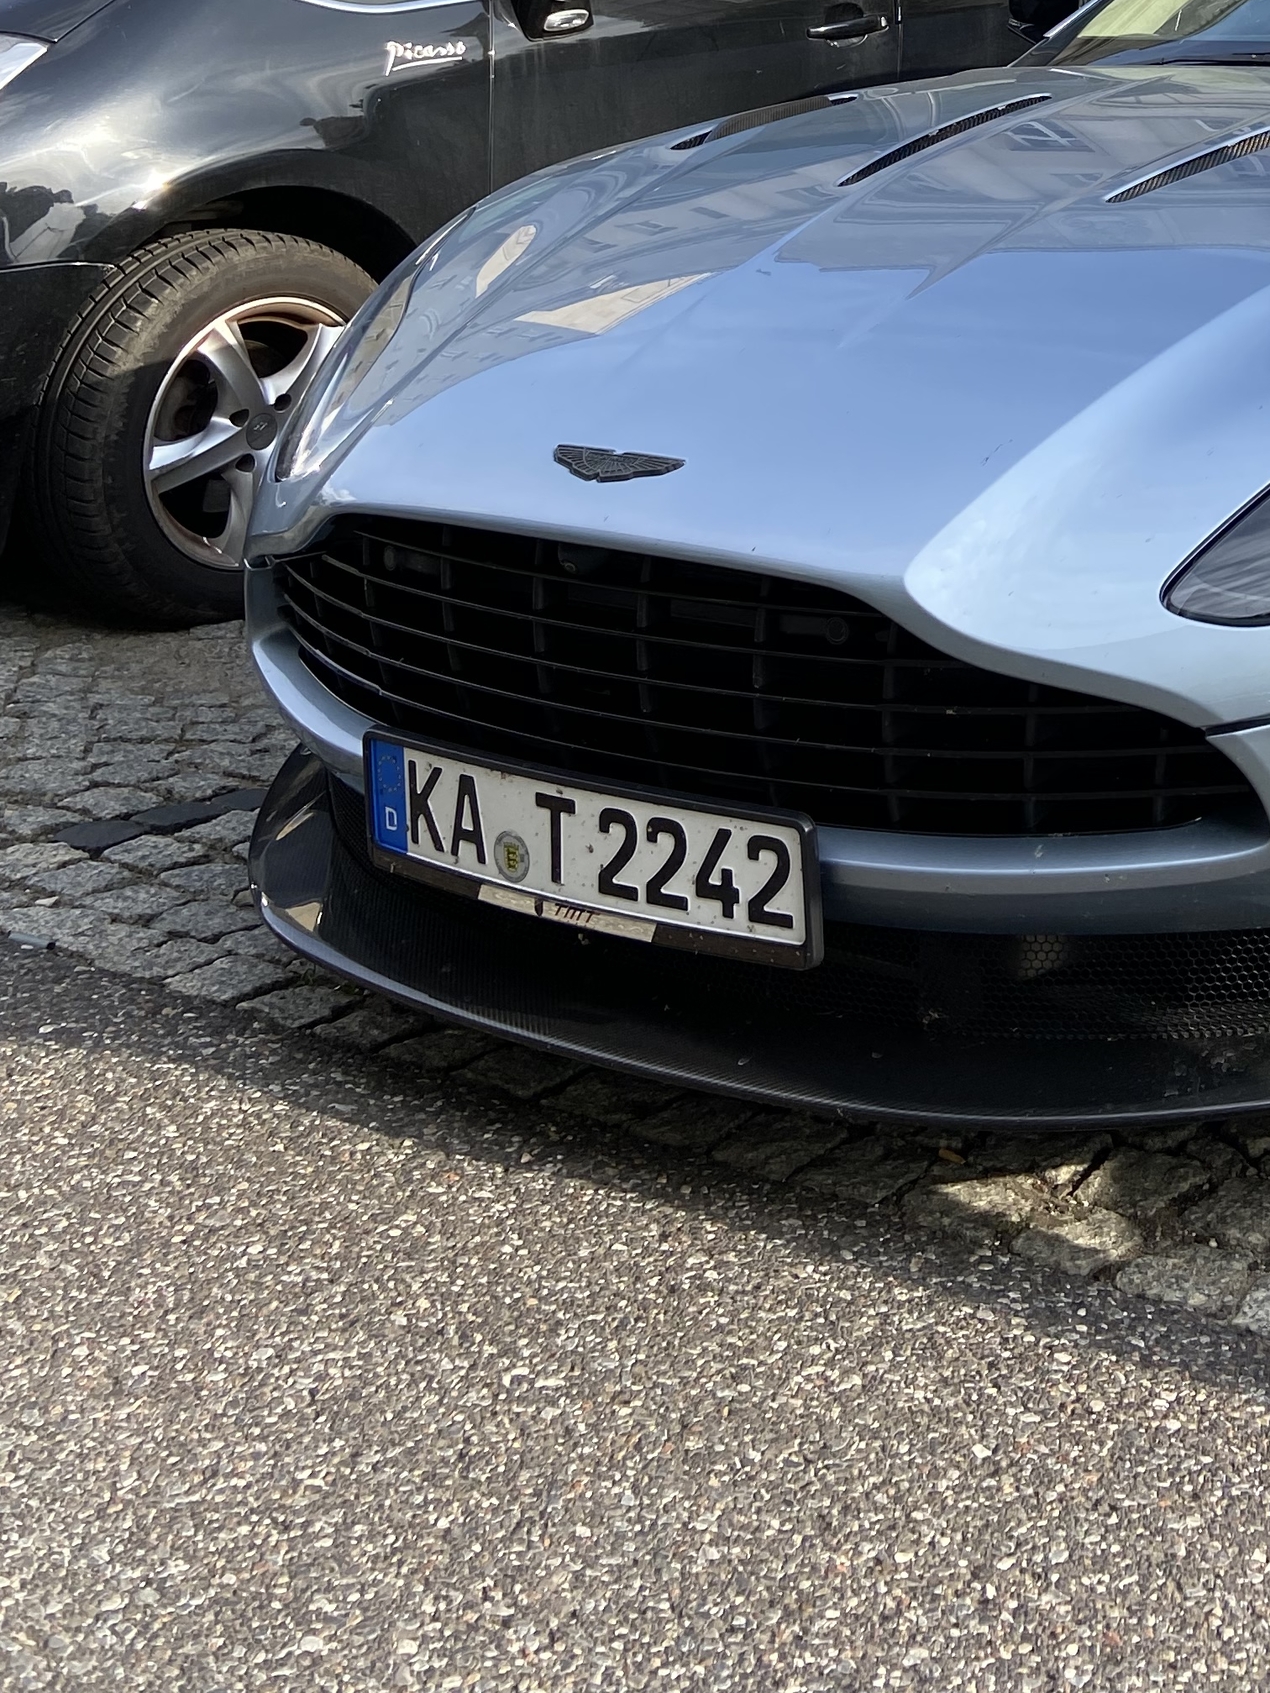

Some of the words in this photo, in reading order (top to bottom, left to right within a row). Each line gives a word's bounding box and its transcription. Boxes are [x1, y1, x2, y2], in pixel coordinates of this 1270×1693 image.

[385, 41, 467, 76] Picasso
[385, 807, 397, 831] D
[407, 759, 487, 865] KA
